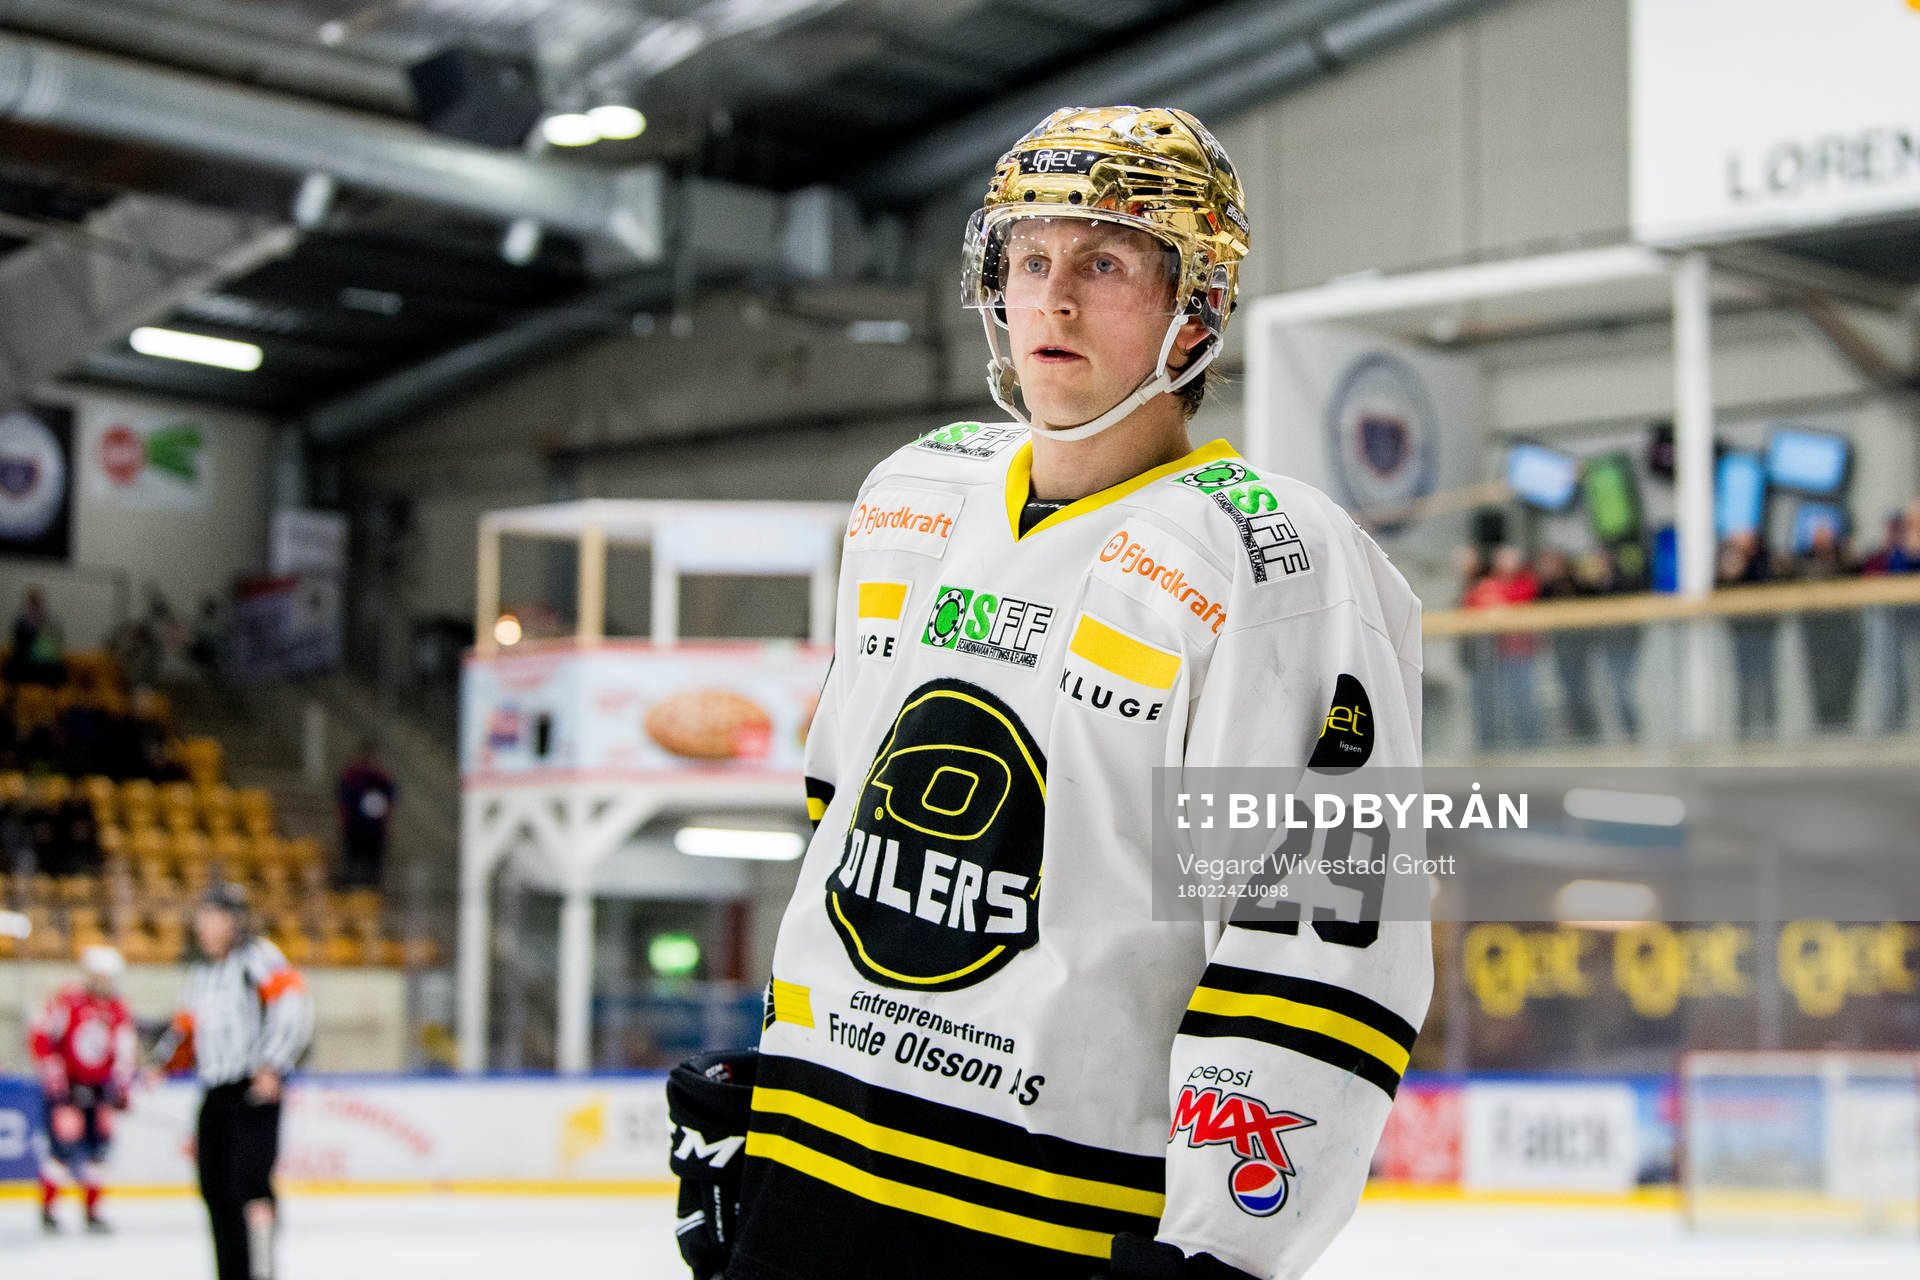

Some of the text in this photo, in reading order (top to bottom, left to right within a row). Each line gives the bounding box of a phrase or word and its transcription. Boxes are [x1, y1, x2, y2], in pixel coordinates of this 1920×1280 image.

[1059, 668, 1163, 721] KLUGE
[1340, 741, 1362, 753] ligaen
[838, 828, 1030, 934] OILERS
[1228, 799, 1392, 949] 29
[829, 1013, 886, 1056] Frode
[895, 1032, 1003, 1089] Olsson
[850, 990, 1015, 1054] Entreprenørfirma
[1187, 1065, 1253, 1088] pepsi
[1168, 1085, 1317, 1176] MAX
